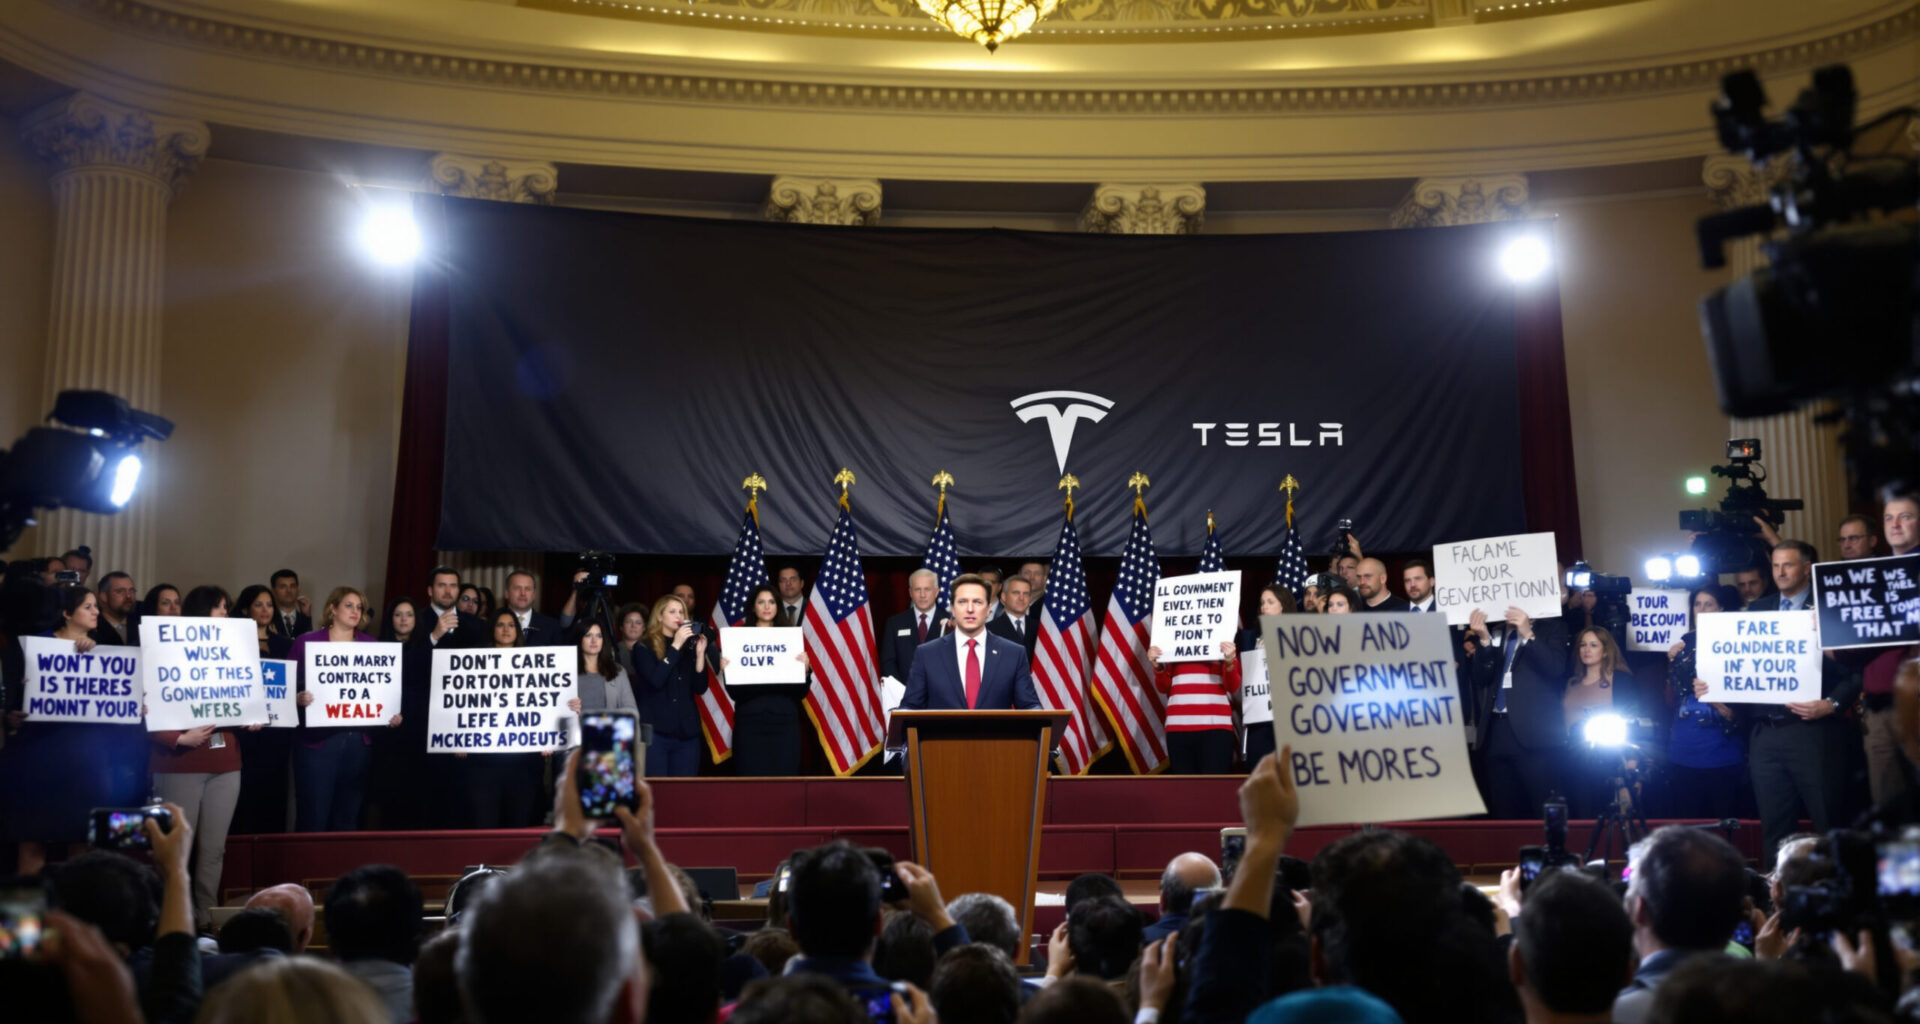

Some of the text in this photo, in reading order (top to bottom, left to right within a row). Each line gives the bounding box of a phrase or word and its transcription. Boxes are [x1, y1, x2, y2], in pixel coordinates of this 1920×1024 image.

[1193, 423, 1343, 446] TESLA
[1452, 541, 1521, 564] FACAME
[1468, 564, 1513, 582] YOUR
[1847, 568, 1876, 584] WE
[1197, 598, 1225, 609] THEN
[1636, 596, 1668, 608] TOUR
[1165, 613, 1222, 626] HE CAE TO
[1632, 613, 1686, 627] BECOUM
[1841, 605, 1885, 622] FREE
[1737, 620, 1780, 635] FARE
[1853, 621, 1904, 638] THAT
[1277, 621, 1410, 658] NOW AND
[184, 646, 231, 661] WUSK
[1174, 645, 1210, 657] MAKE
[100, 656, 136, 676] YOU
[315, 655, 396, 667] ELON MARRY
[450, 653, 556, 671] DON'T CARE
[1752, 659, 1796, 673] YOUR
[158, 666, 253, 682] DO OF THES
[318, 672, 392, 684] CONTRACTS
[442, 673, 572, 690] FORTONTANCS
[1289, 661, 1447, 696] GOVERNMENT
[40, 676, 132, 696] IS THERES
[1724, 676, 1799, 691] REALTHD
[339, 688, 370, 700] FO A
[443, 691, 561, 709] DUNN'S EASY
[30, 698, 90, 716] MONNT
[190, 703, 242, 718] WFERS
[326, 703, 383, 719] WEAL?
[457, 711, 541, 728] LEFE AND
[1291, 697, 1454, 735] GOVERMENT
[431, 731, 568, 748] MCKERS APOEUTS
[1292, 747, 1441, 787] BE MORES
